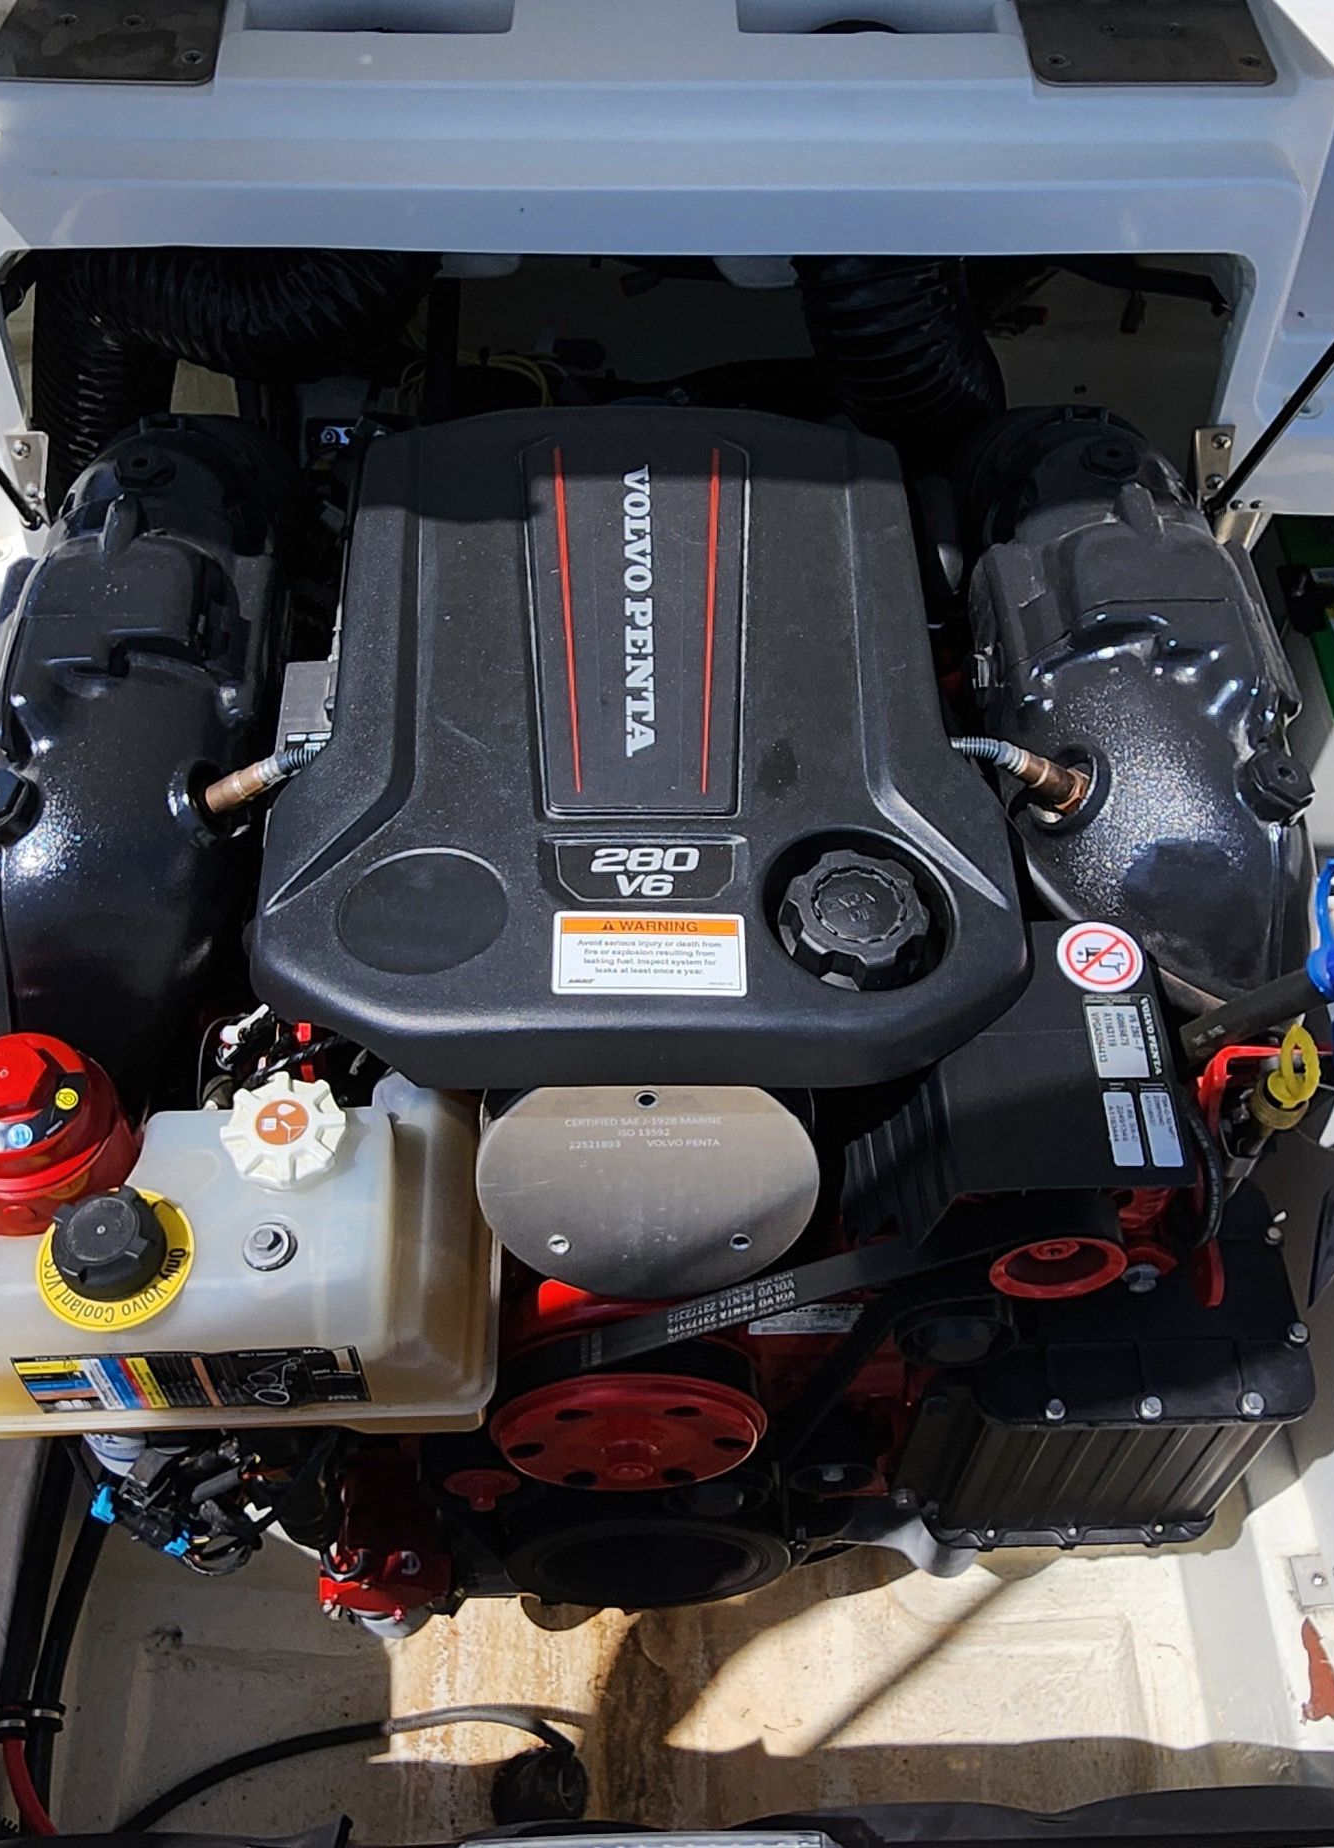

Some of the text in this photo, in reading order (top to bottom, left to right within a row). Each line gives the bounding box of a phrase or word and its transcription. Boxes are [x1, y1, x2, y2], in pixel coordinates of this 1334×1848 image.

[623, 464, 656, 757] VOLVO PENTA
[590, 847, 700, 873] 280
[616, 874, 675, 897] V6
[618, 919, 699, 933] WARNING
[578, 939, 602, 947] Avoid
[638, 940, 662, 949] injury
[676, 940, 700, 948] death
[612, 948, 654, 958] explosion
[656, 949, 693, 957] resulting
[584, 957, 615, 966] leaking
[637, 958, 669, 966] Inspect
[671, 959, 702, 967] system
[1140, 996, 1155, 1036] VOLVO
[1148, 1035, 1163, 1076] PENTA
[564, 1118, 618, 1127] CERTIFIED
[620, 1117, 638, 1126] SAE
[679, 1116, 723, 1126] MARINE
[617, 1128, 635, 1137] ISO
[646, 1139, 683, 1148] VOLVO
[685, 1138, 720, 1147] PENTA
[758, 1279, 796, 1297] VOLVO
[54, 1287, 115, 1324] Coolant
[121, 1285, 168, 1317] Volvo
[719, 1291, 755, 1308] PENTA
[758, 1290, 796, 1308] VOLVO
[719, 1301, 756, 1319] PENTA
